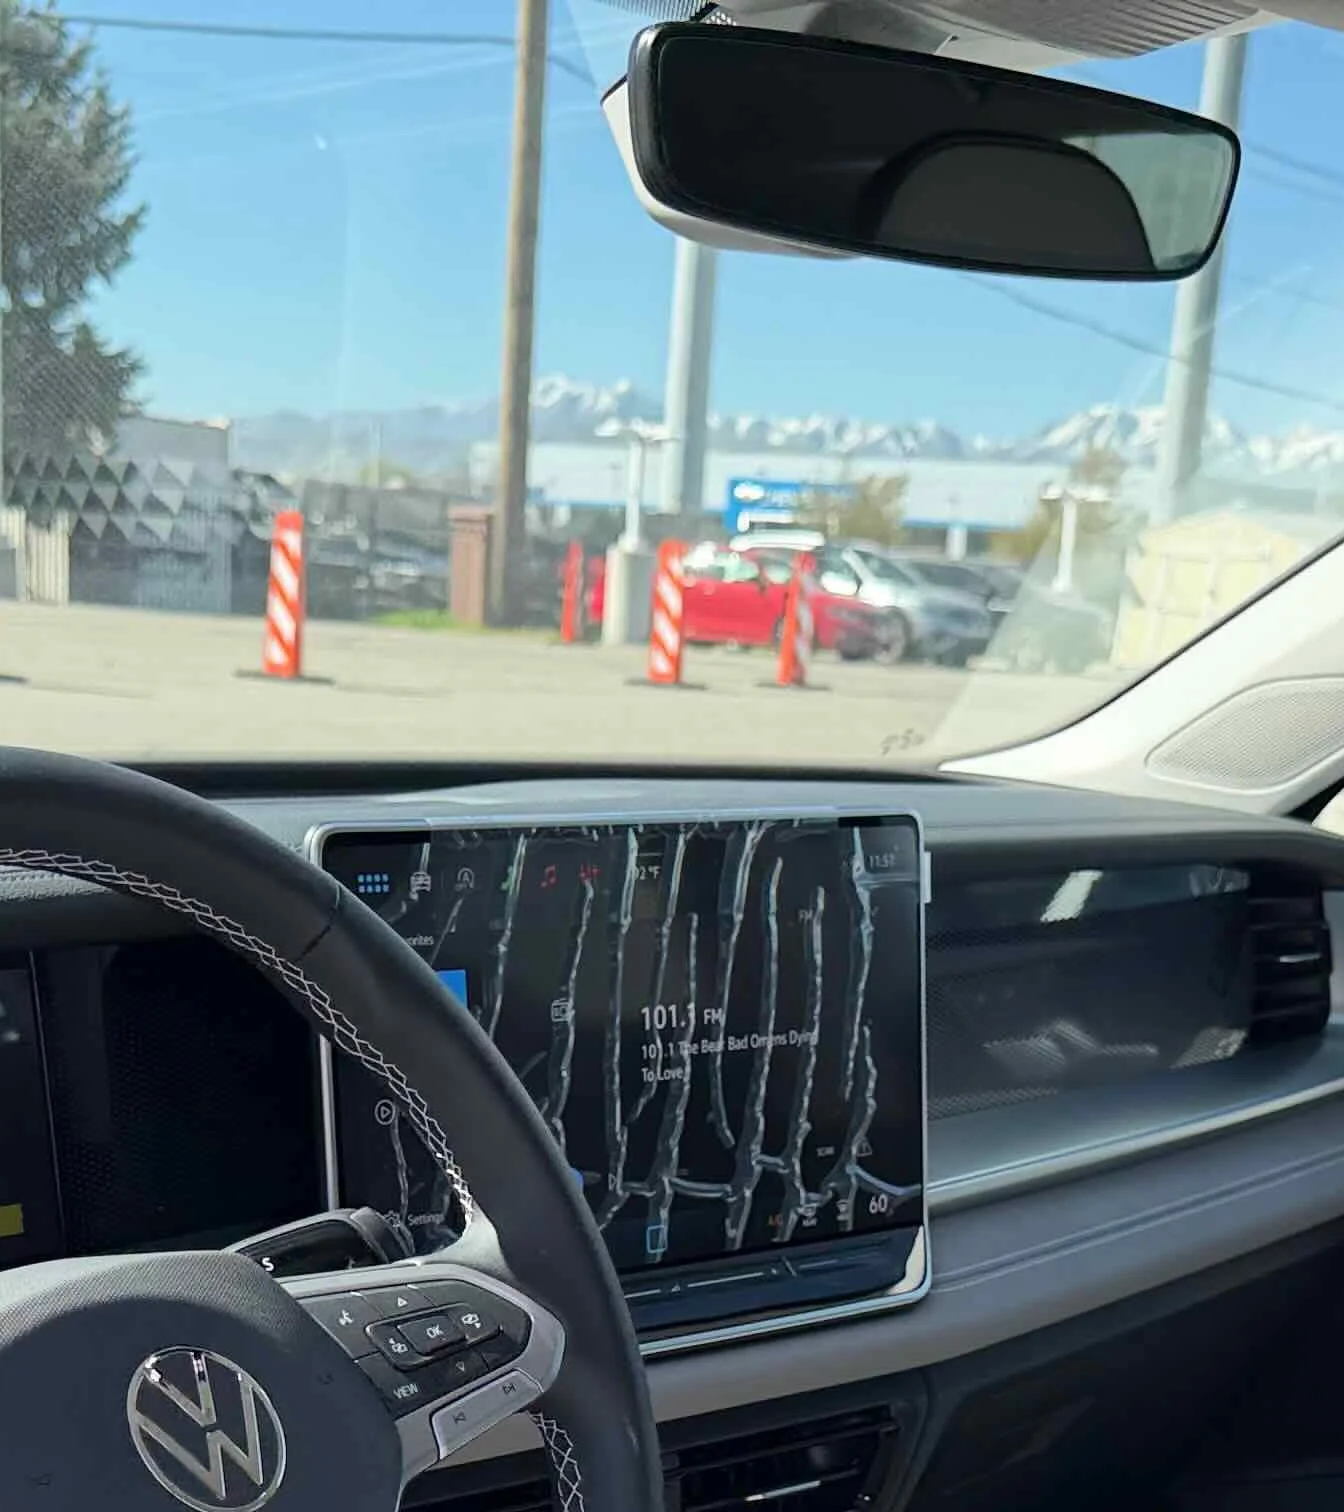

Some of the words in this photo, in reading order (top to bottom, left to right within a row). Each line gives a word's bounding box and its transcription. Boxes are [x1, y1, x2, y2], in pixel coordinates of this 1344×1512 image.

[641, 1002, 695, 1031] 101.1
[703, 1008, 723, 1025] FM
[641, 1043, 674, 1060] 10.1
[728, 1035, 749, 1051] Bad
[641, 1067, 654, 1082] To
[657, 1067, 683, 1081] Love
[868, 1194, 888, 1214] 60
[408, 1213, 444, 1225] Settings
[261, 1257, 275, 1272] S
[425, 1324, 443, 1339] OK
[393, 1382, 419, 1399] VIEW
